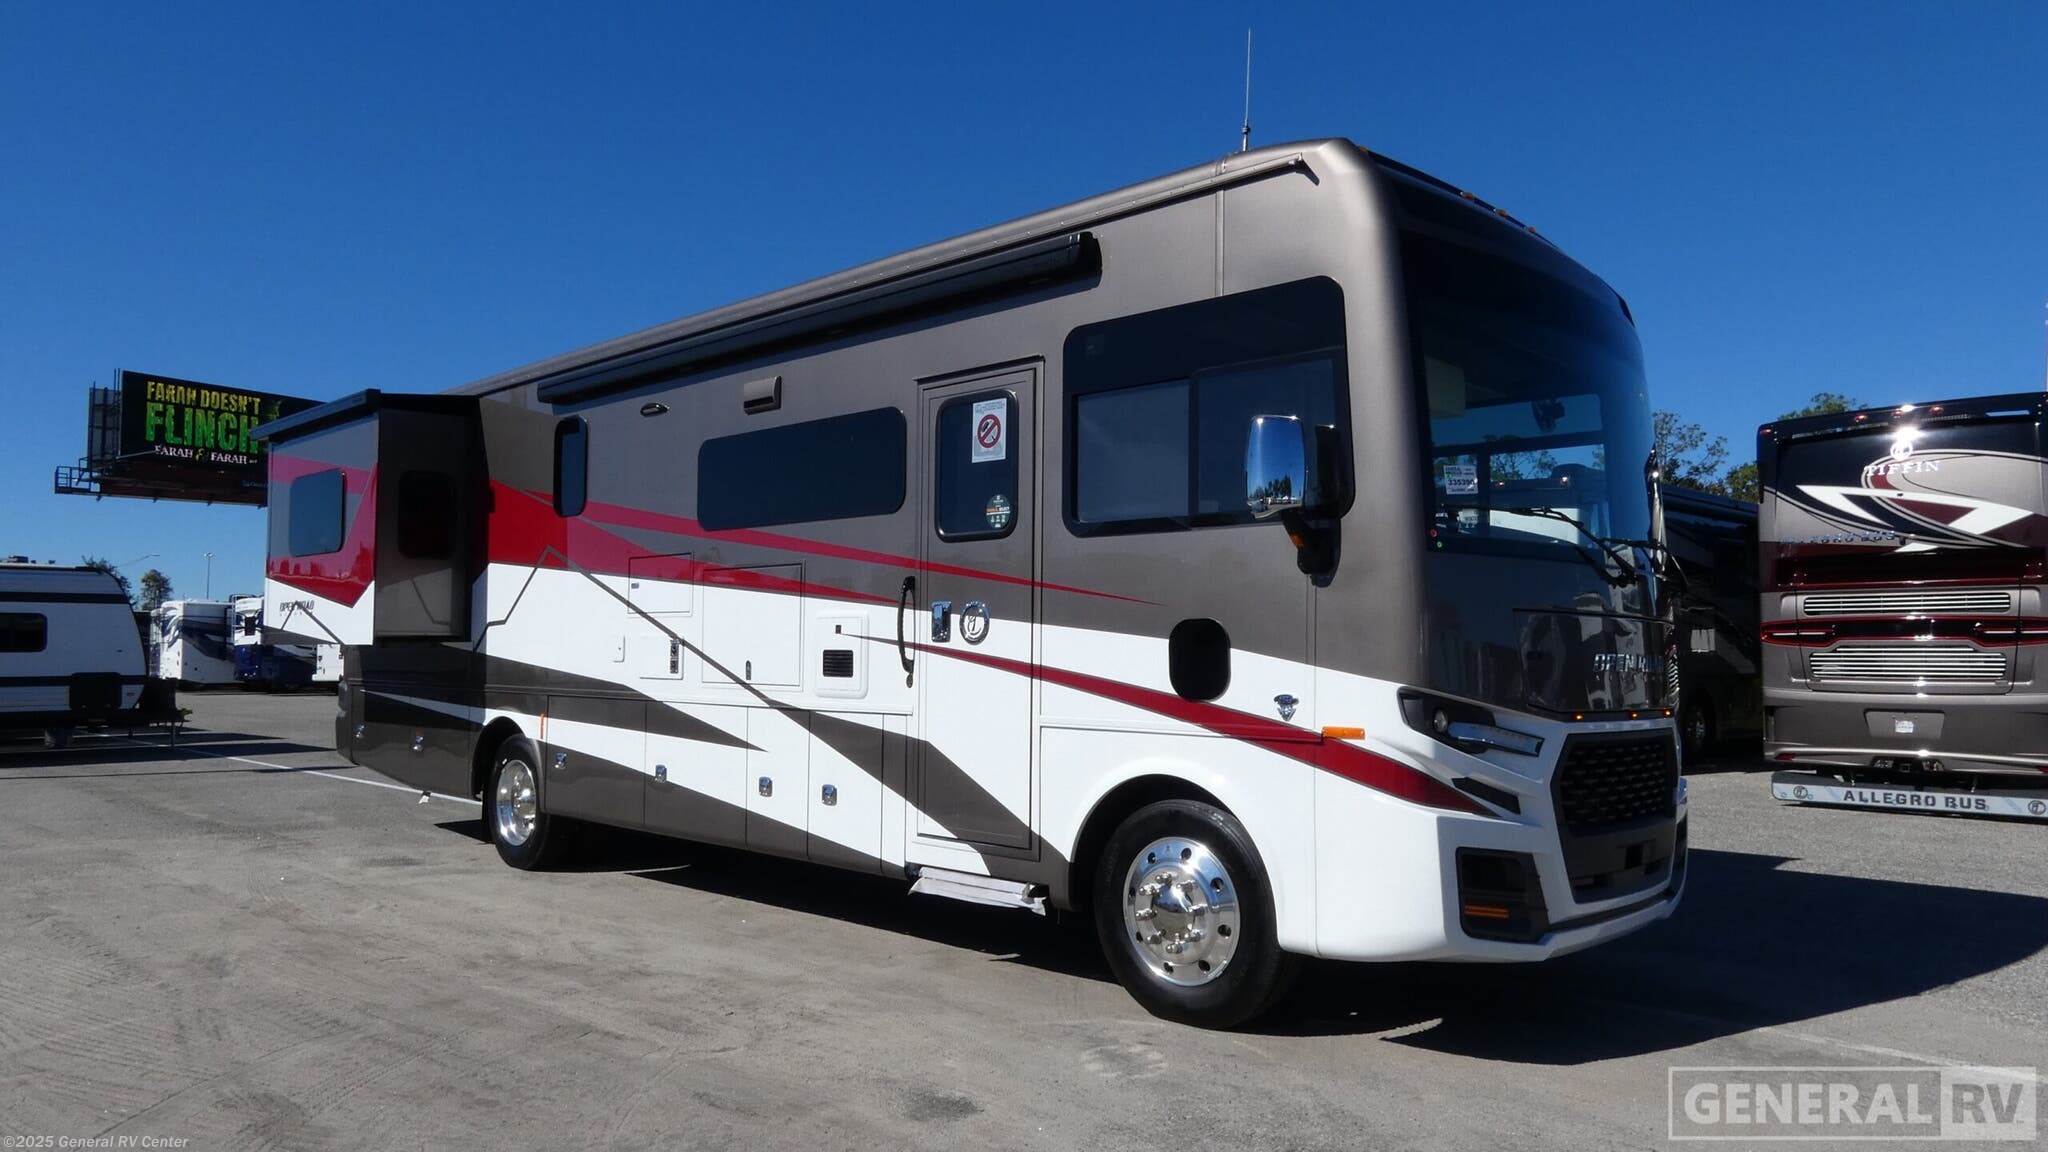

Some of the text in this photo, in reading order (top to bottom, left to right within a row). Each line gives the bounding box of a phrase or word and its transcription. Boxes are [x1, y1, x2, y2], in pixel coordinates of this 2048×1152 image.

[147, 381, 261, 415] FARAH DOESN'T
[145, 401, 259, 454] FLINCH
[155, 445, 194, 458] FARAH
[211, 452, 247, 464] FARAH
[1864, 460, 1940, 476] TIFFIN
[1593, 653, 1636, 672] OPEN
[1843, 790, 1987, 810] ALLEGRO BUS
